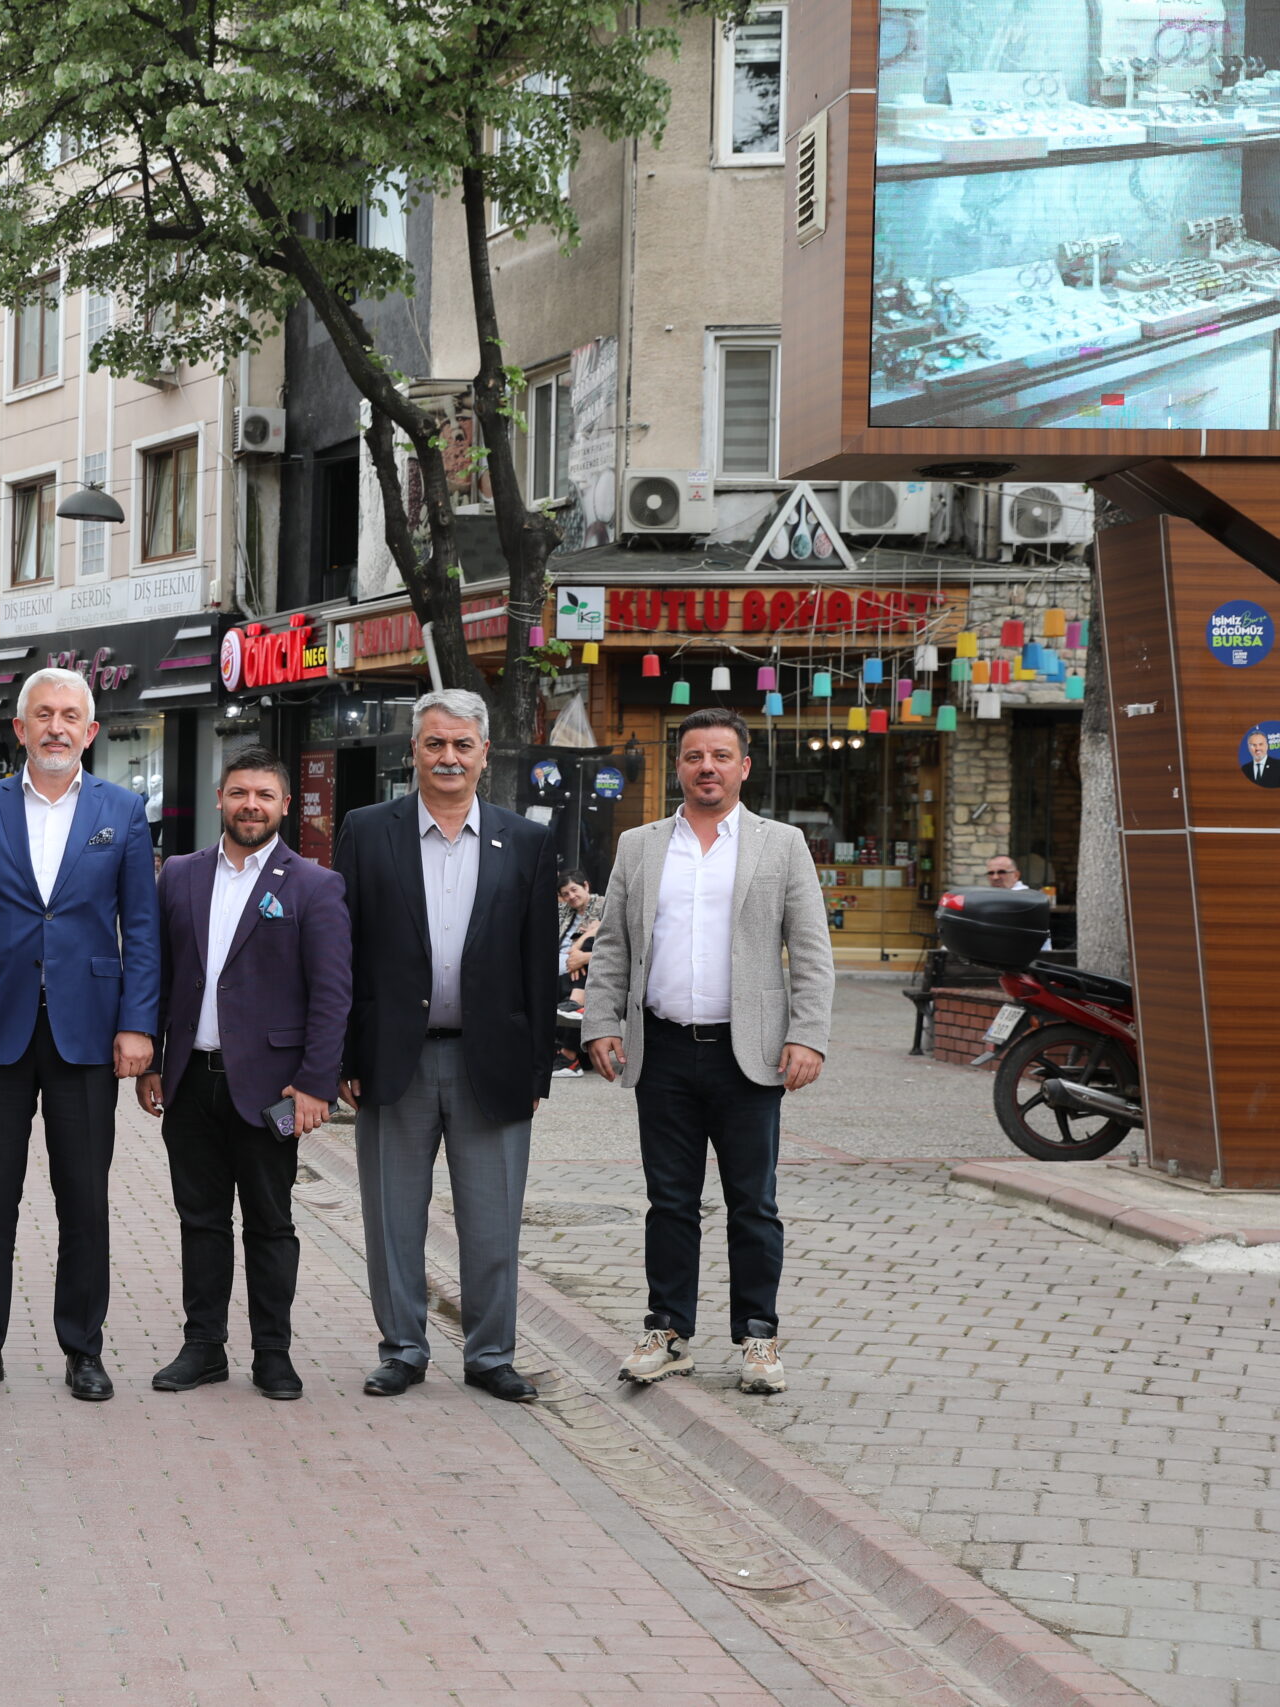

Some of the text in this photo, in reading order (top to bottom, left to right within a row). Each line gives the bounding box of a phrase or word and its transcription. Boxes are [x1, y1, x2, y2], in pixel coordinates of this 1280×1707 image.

[71, 584, 112, 611] ESERDİŞ
[133, 570, 195, 602] DİŞ HEKİMİ
[4, 603, 19, 623] DİŞ
[19, 593, 53, 618] HEKİMİ
[609, 589, 730, 633] KUTLU
[1212, 624, 1264, 636] GÜCÜMÜZ
[1212, 635, 1263, 648] BURSA
[302, 644, 328, 669] İNEG
